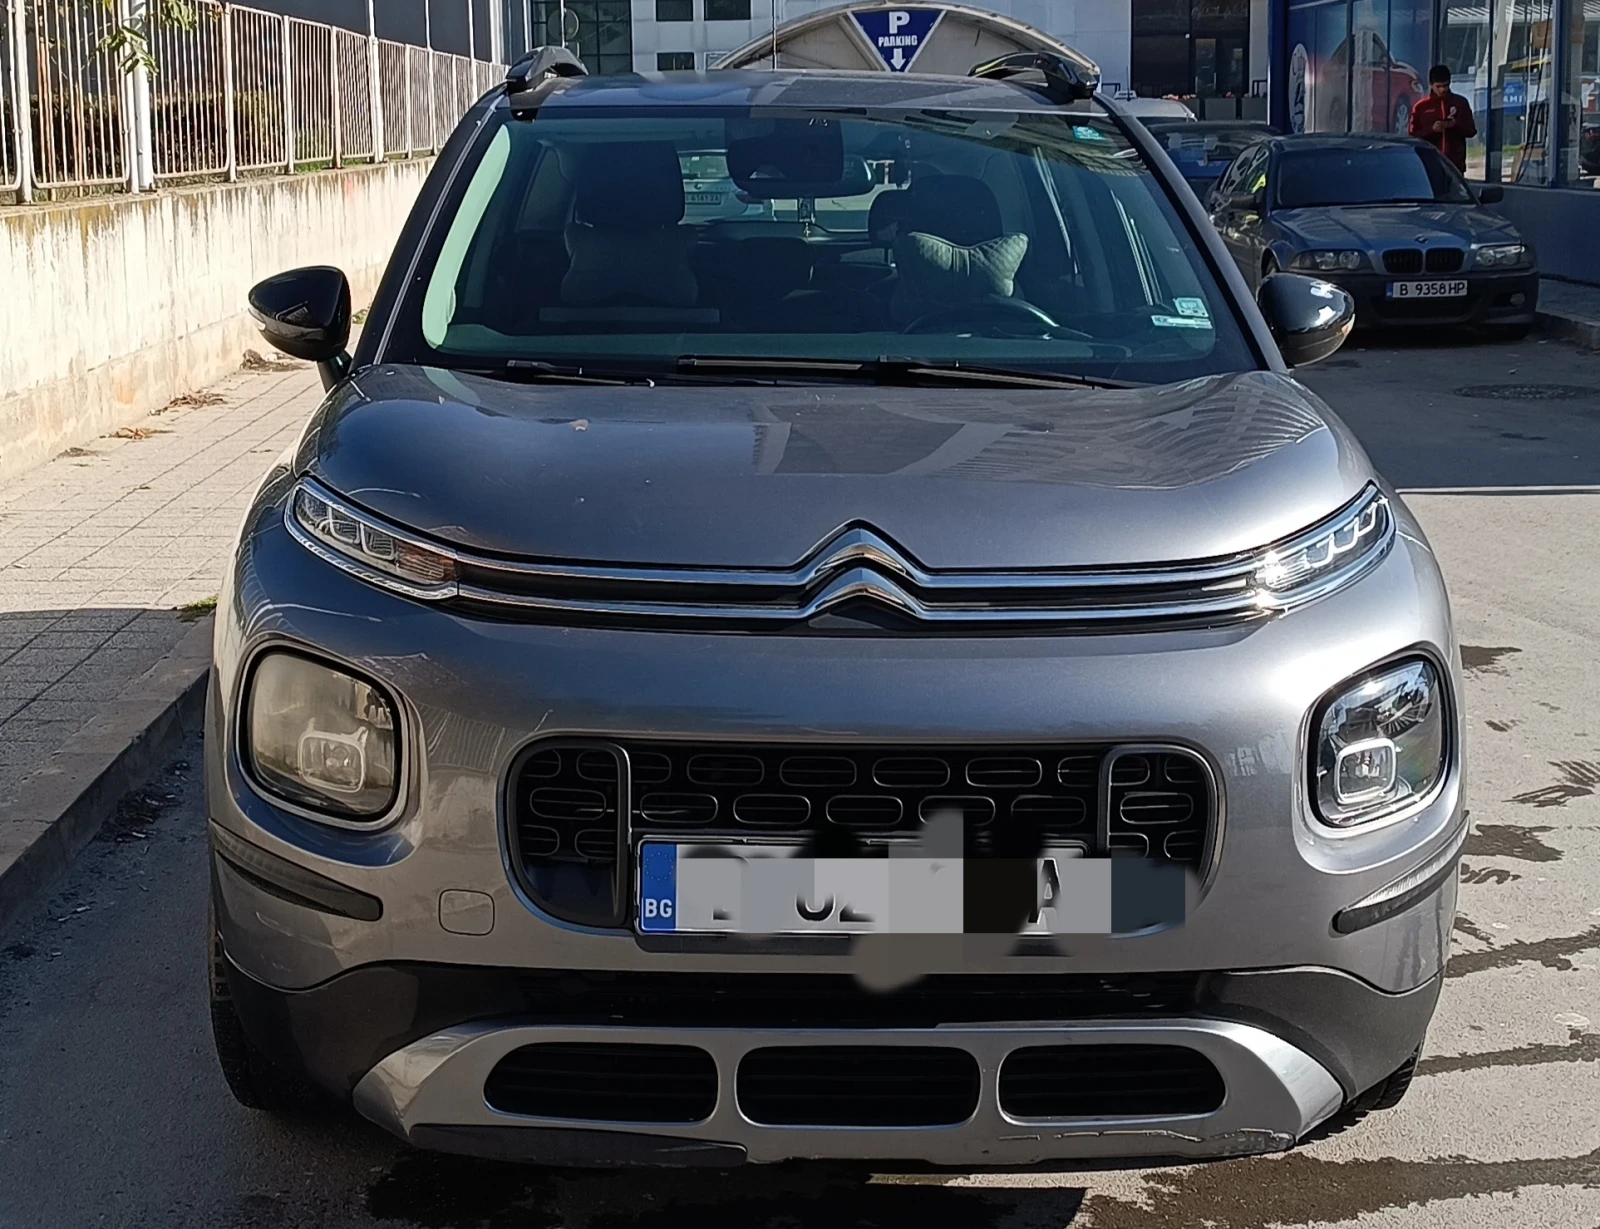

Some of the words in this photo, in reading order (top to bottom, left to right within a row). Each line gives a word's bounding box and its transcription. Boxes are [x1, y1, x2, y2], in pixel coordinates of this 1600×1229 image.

[889, 11, 910, 34] P
[878, 35, 918, 47] PARKING
[1400, 283, 1409, 296] B
[645, 898, 673, 918] BG
